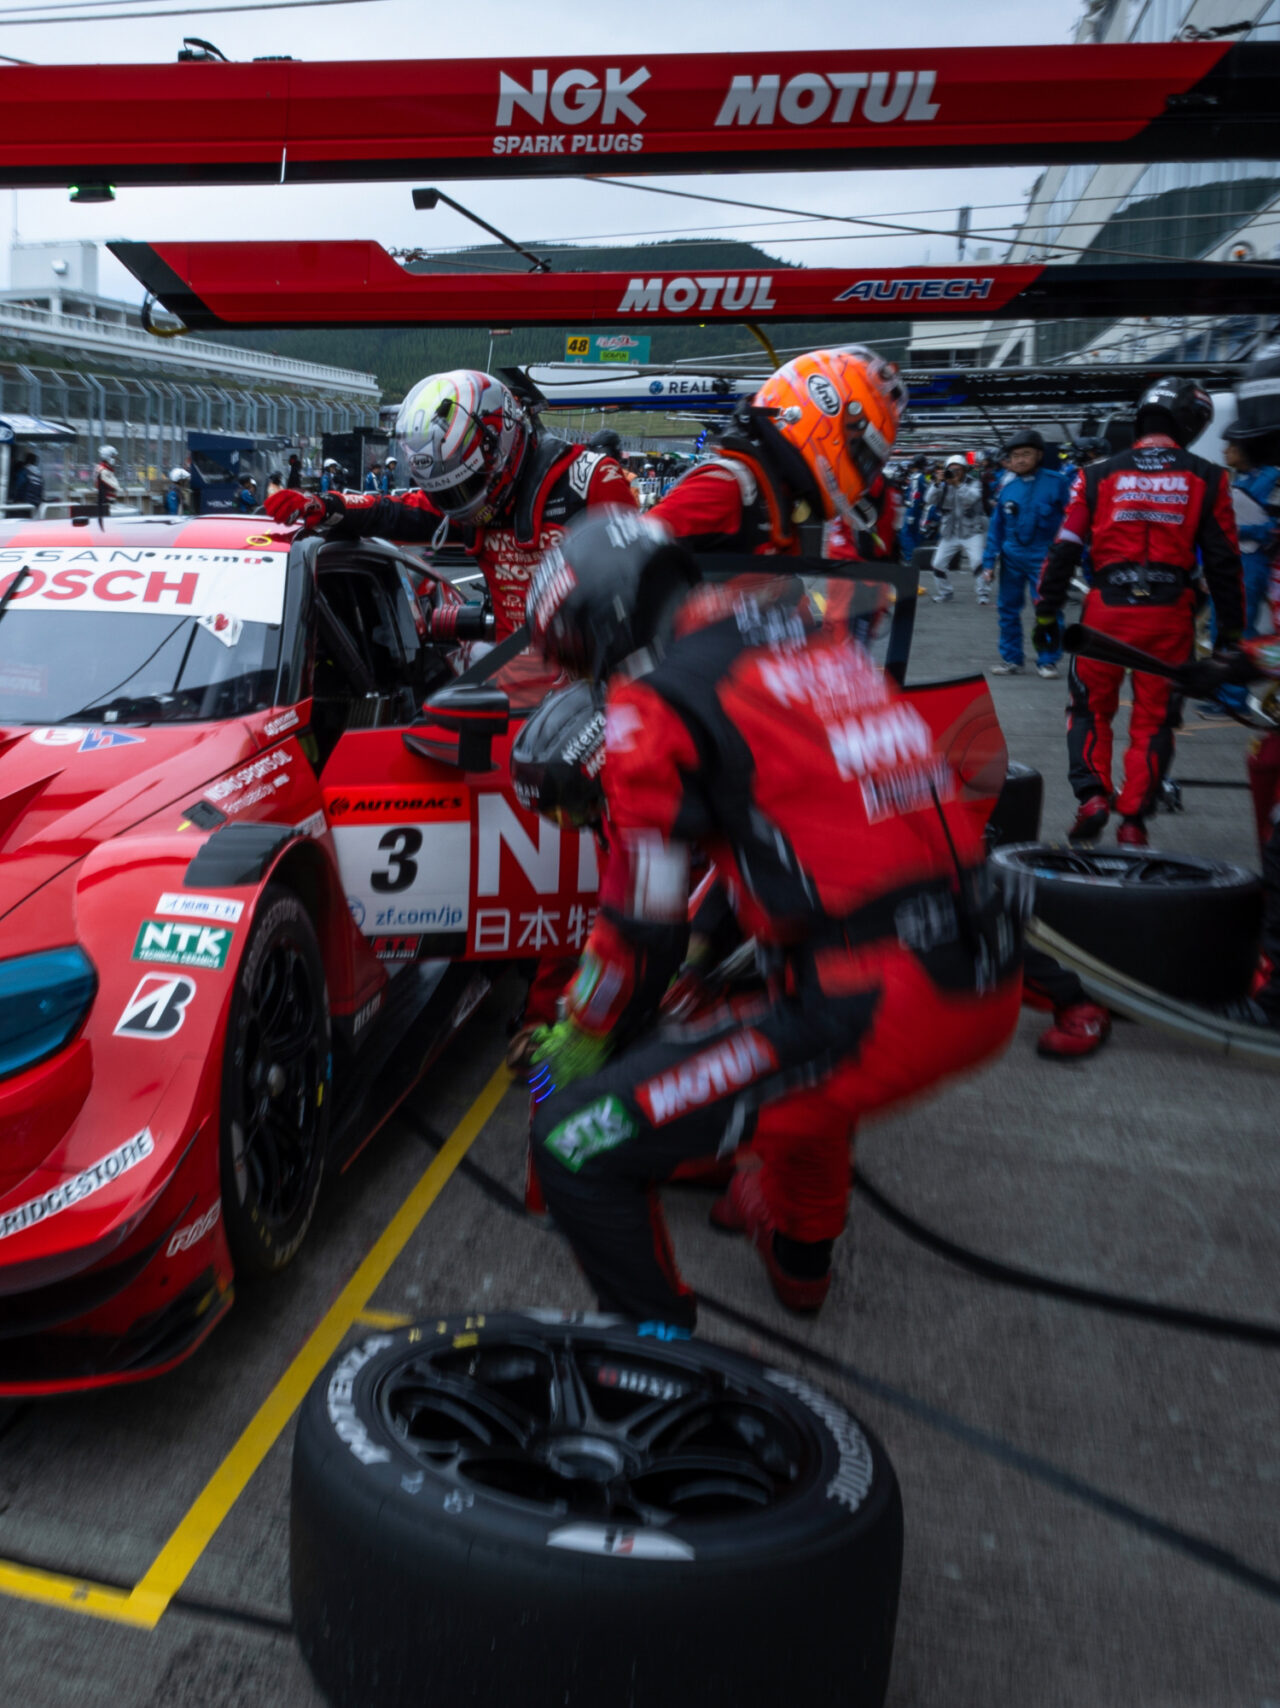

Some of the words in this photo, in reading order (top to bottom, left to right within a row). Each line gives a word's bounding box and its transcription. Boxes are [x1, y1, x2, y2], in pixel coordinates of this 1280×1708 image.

[495, 65, 652, 126] NGK
[714, 70, 941, 126] MOTUL
[492, 135, 565, 155] SPARK
[571, 133, 644, 152] PLUGS
[617, 276, 776, 313] MOTUL
[832, 278, 995, 301] AUTECH
[568, 338, 589, 352] 48
[1116, 475, 1190, 493] MOTUL
[1112, 491, 1189, 505] AUTECH
[351, 797, 463, 812] AUTOBACS
[370, 826, 424, 894] 3
[375, 904, 463, 927] zf.com/jp
[140, 921, 227, 957] NTK
